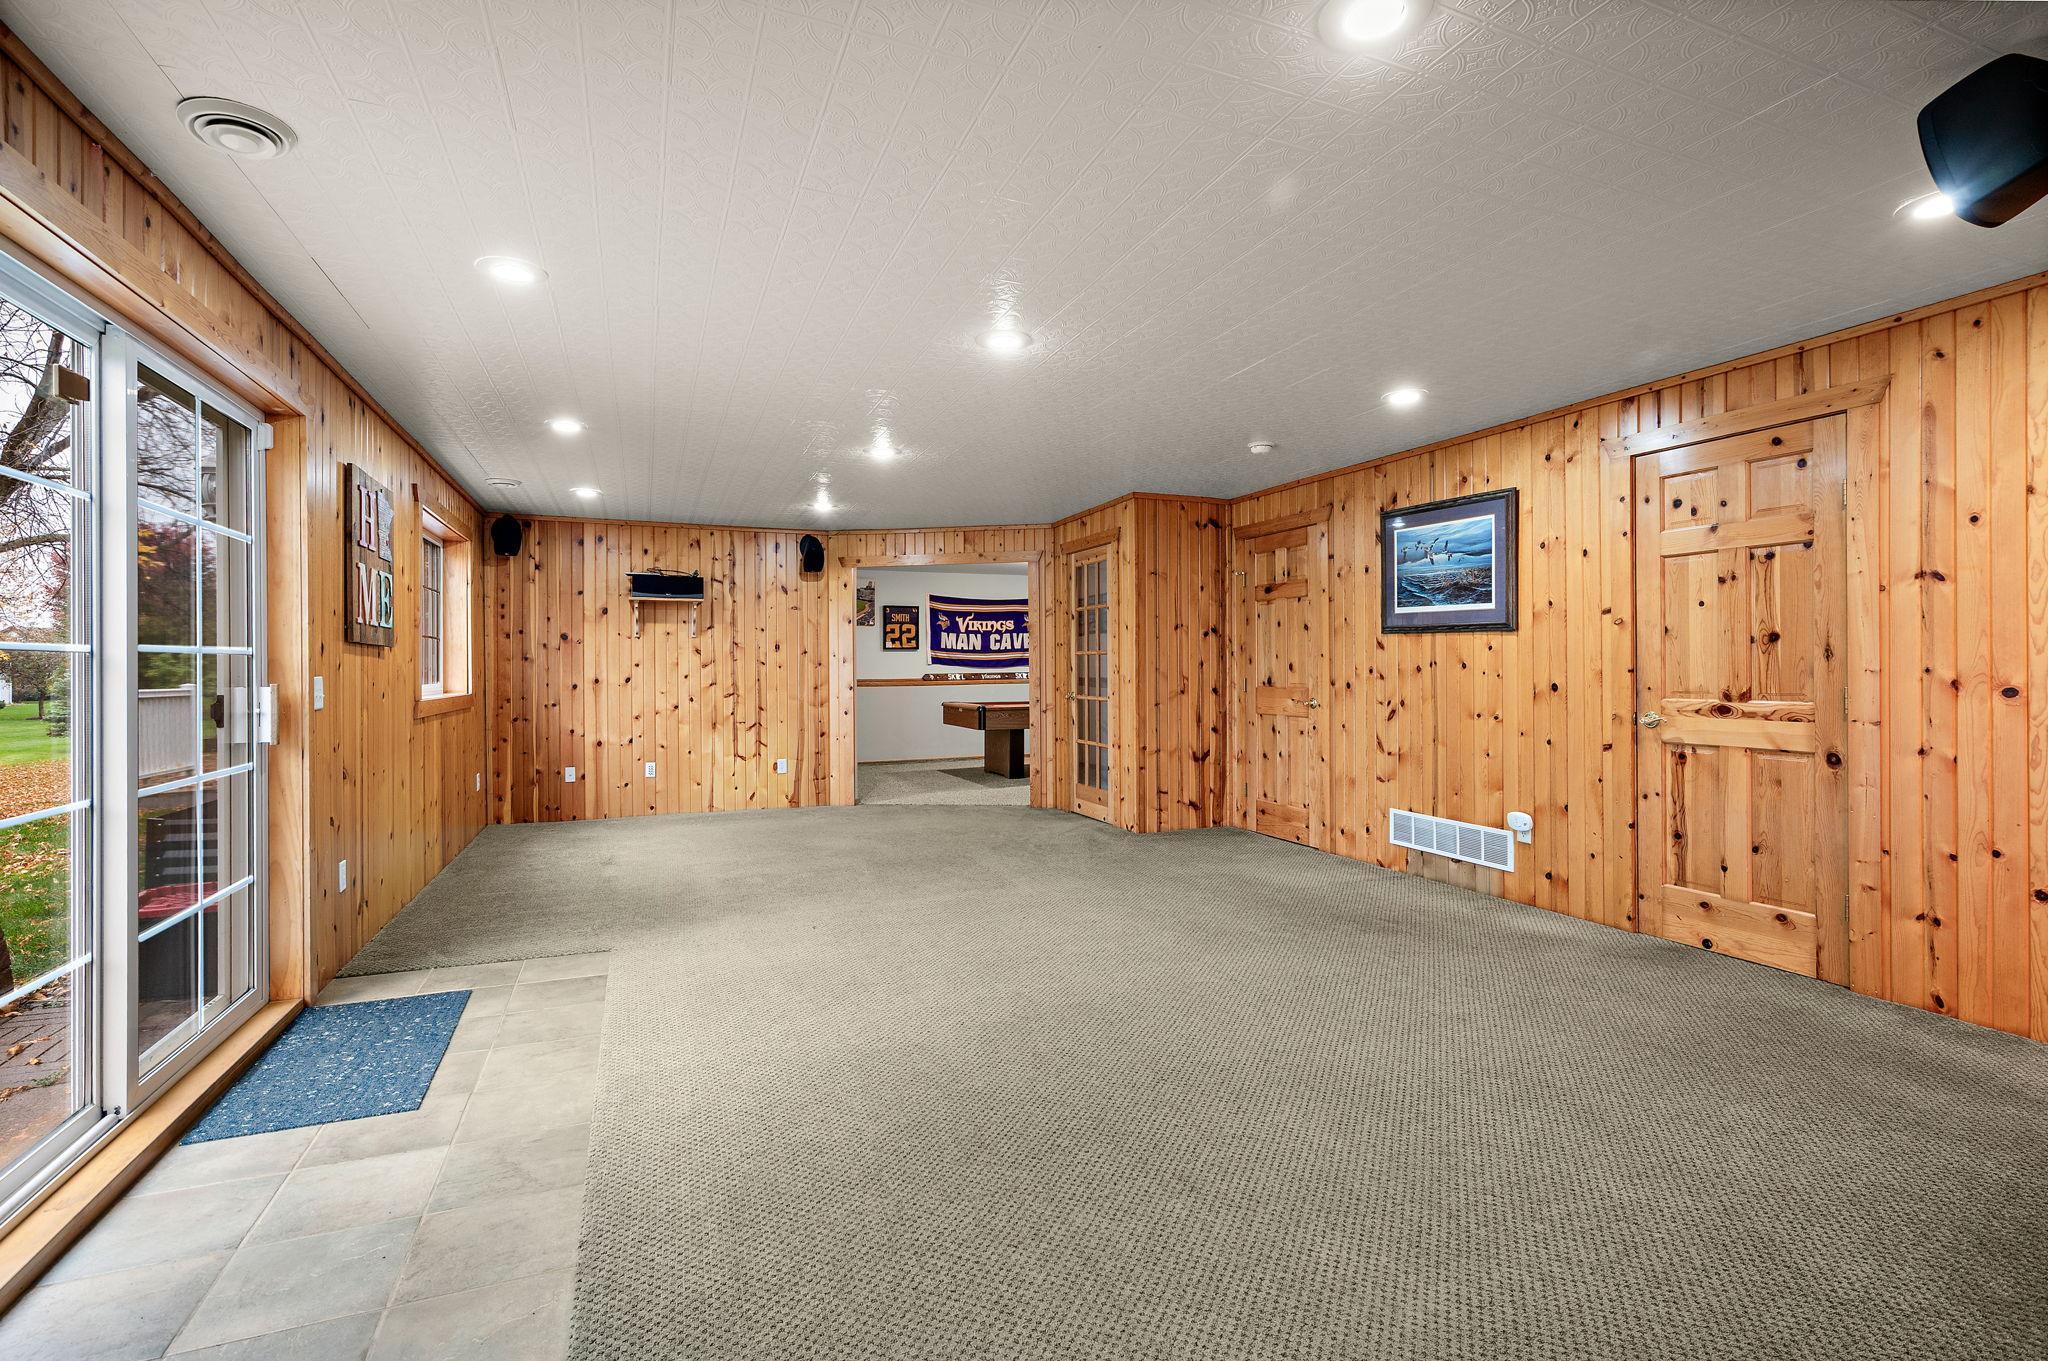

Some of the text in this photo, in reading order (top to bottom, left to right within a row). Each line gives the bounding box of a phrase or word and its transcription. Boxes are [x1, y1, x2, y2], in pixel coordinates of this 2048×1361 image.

[891, 613, 910, 622] SMITH
[886, 624, 916, 648] 22
[940, 632, 982, 650] MAN
